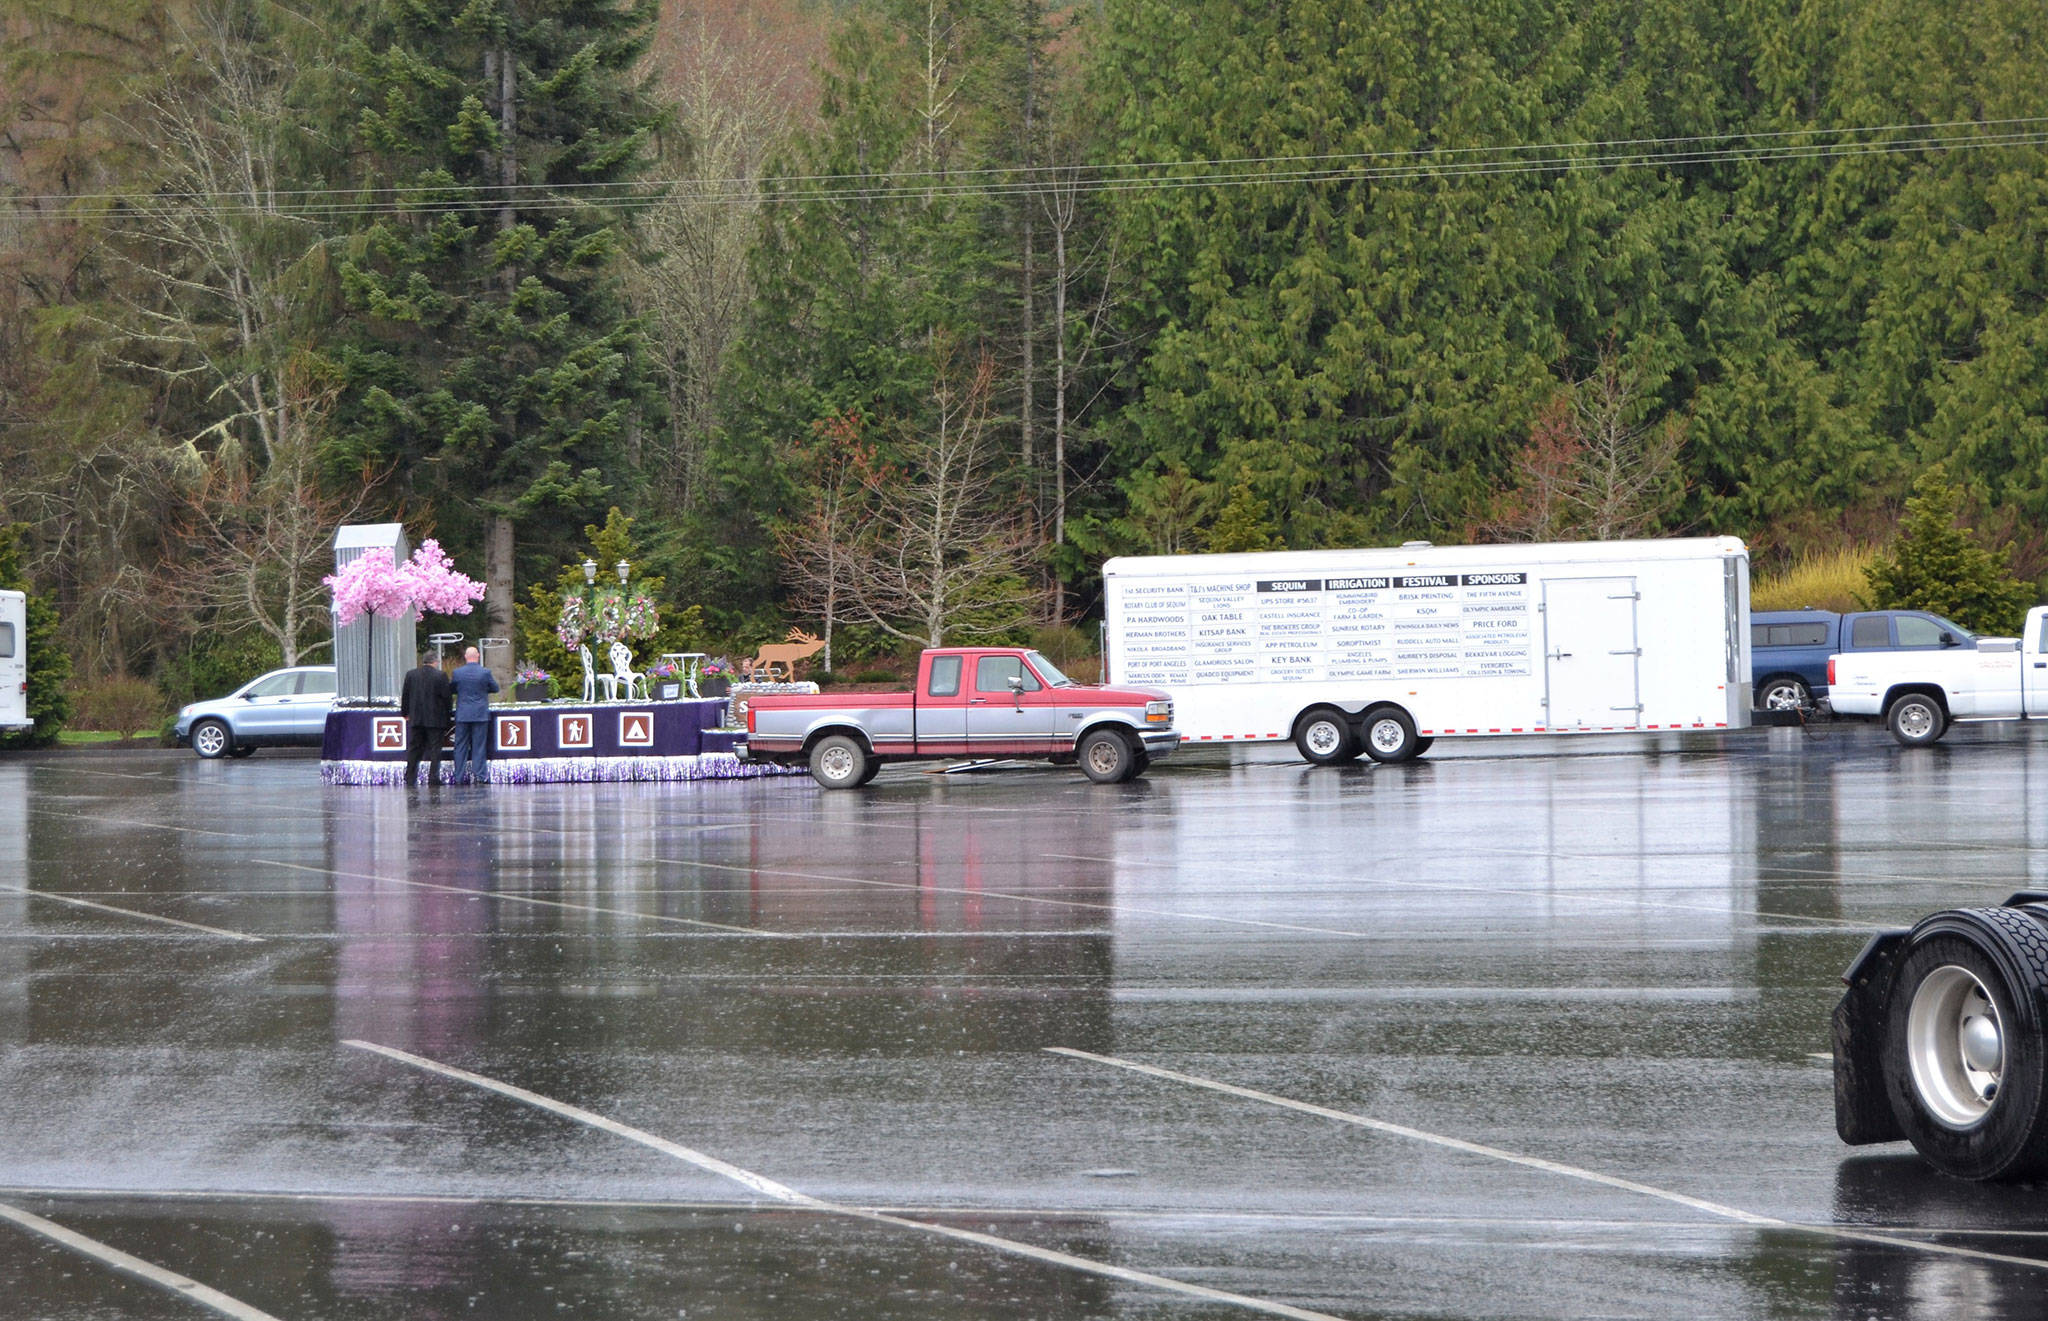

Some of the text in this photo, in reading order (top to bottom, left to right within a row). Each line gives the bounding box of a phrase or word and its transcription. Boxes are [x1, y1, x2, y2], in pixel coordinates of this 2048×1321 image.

[1207, 584, 1233, 592] MACHINE
[1235, 583, 1251, 591] SHOP
[1272, 574, 1521, 592] SEQUIM IRRIGATION FESTIVAL SPONSORS
[1272, 656, 1287, 664] KEY
